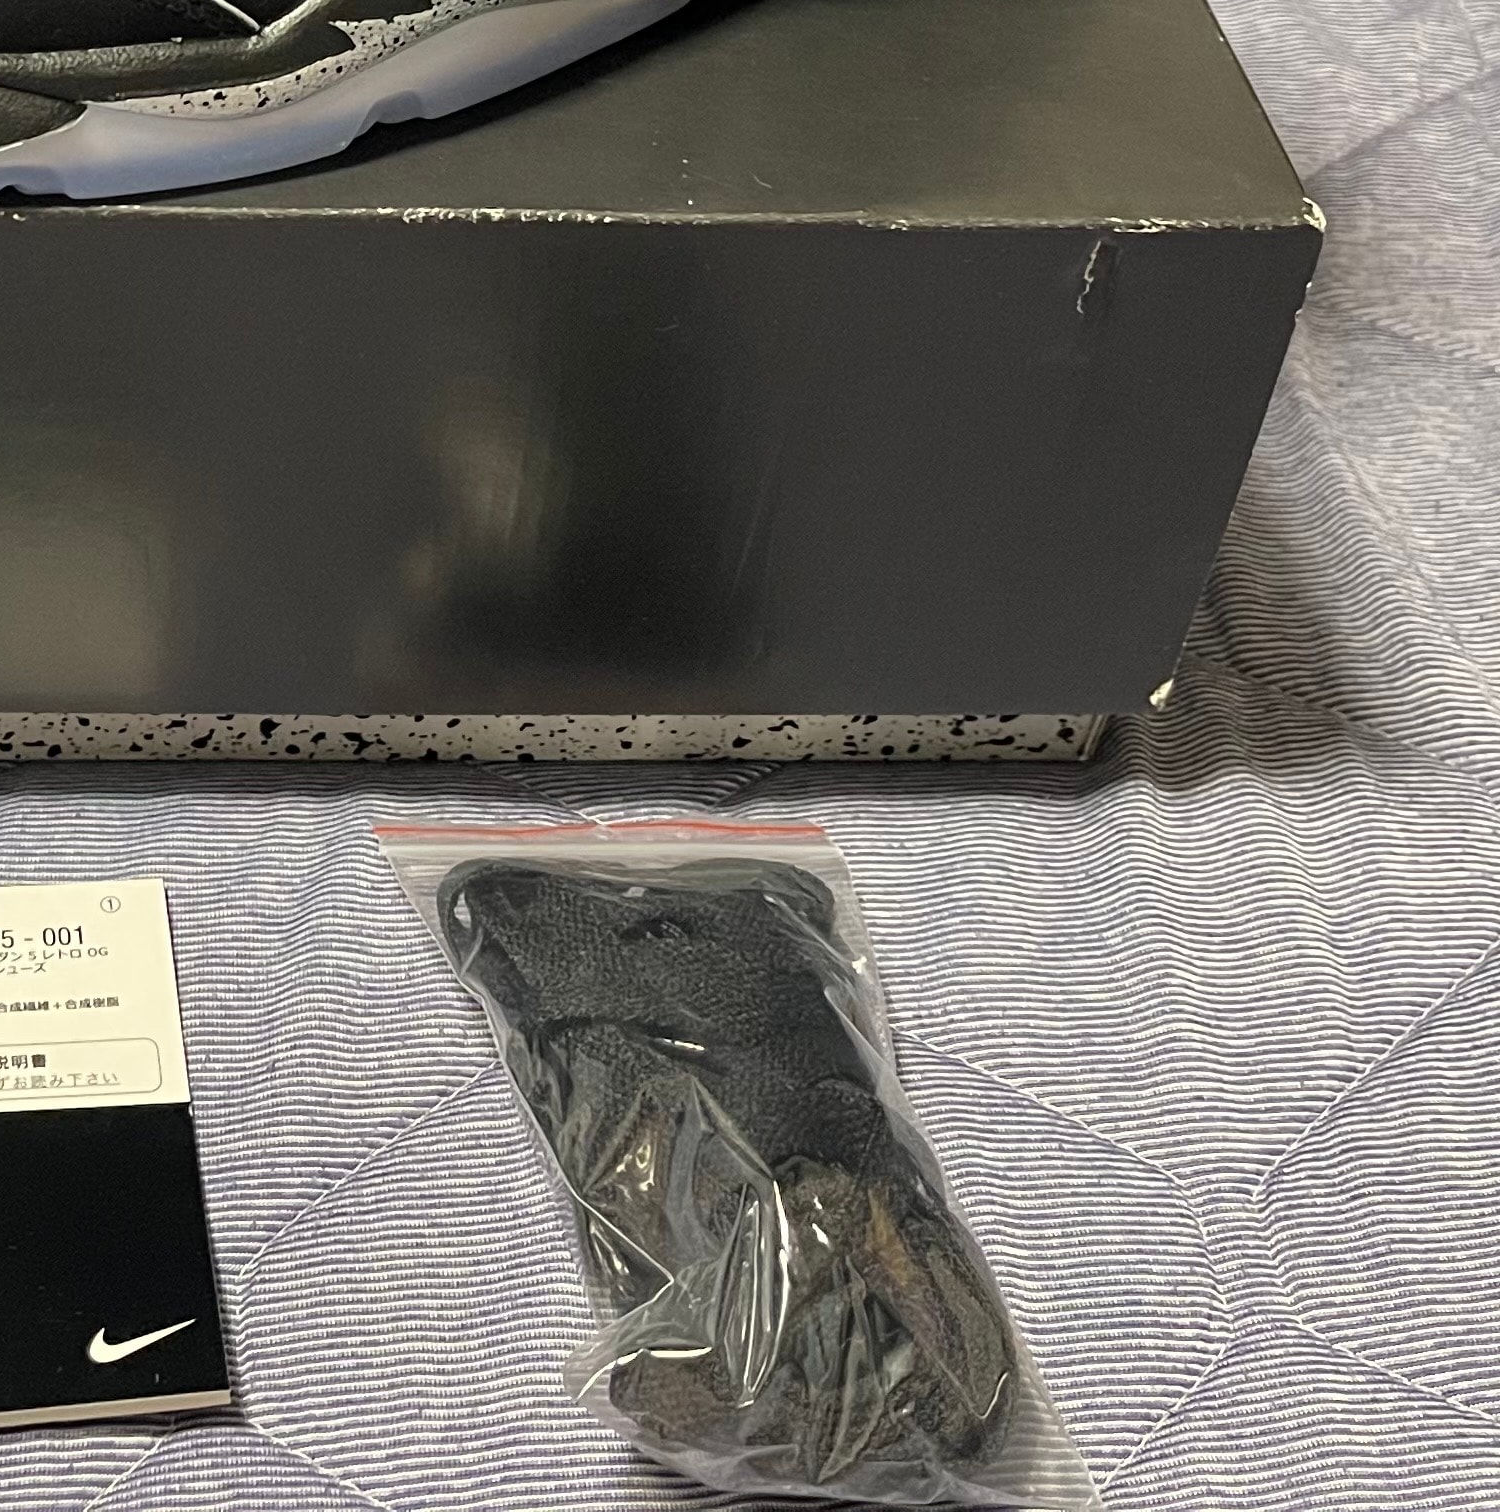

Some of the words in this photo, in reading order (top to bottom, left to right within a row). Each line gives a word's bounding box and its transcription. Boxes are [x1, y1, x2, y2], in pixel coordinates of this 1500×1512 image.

[42, 925, 84, 947] 001
[28, 950, 37, 961] 5
[43, 947, 82, 960] レトロ
[87, 946, 109, 957] OG
